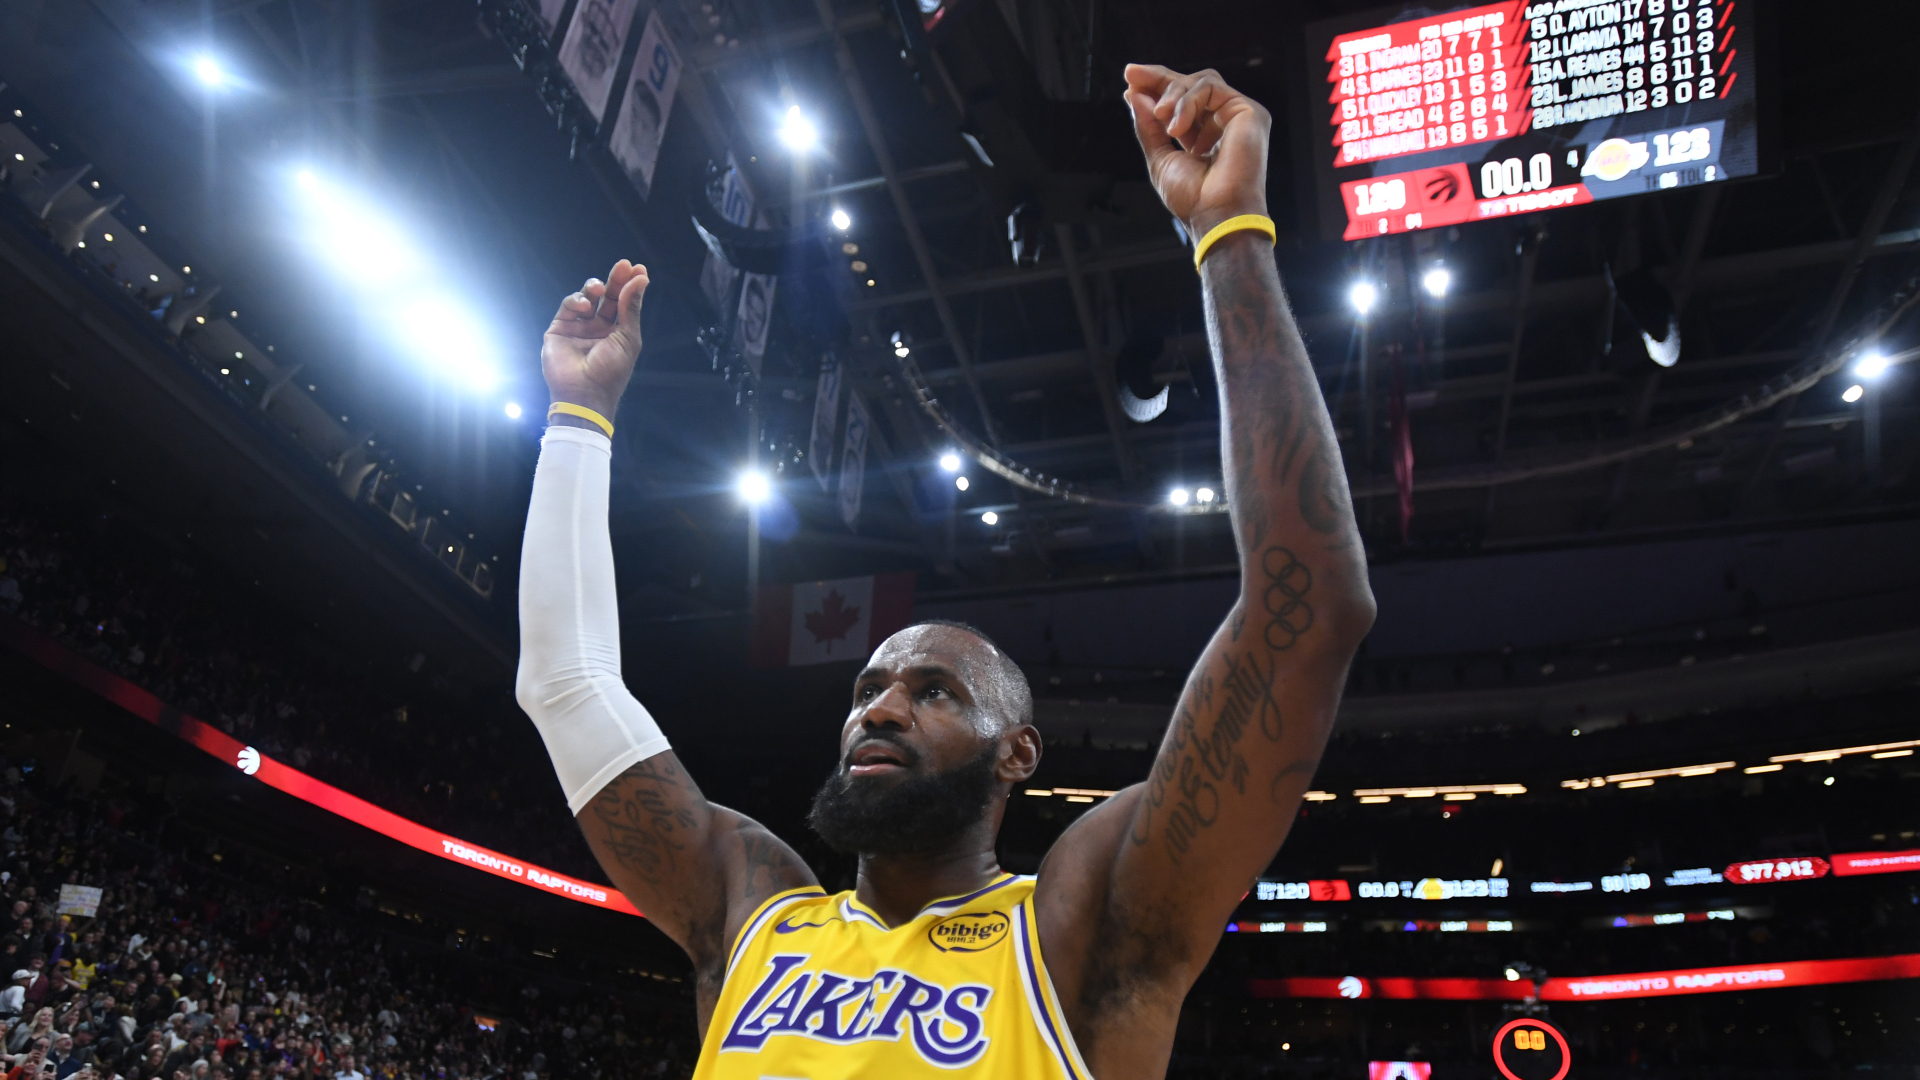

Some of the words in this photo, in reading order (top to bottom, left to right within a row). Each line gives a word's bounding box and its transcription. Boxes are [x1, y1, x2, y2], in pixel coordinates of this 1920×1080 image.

[1530, 17, 1547, 39] 5
[1550, 14, 1566, 36] D.
[1568, 2, 1620, 32] AYTON
[1622, 0, 1643, 22] 17
[1530, 40, 1551, 63] 12
[1562, 26, 1620, 56] LARAVIA
[1622, 21, 1644, 44] 14
[1649, 16, 1664, 38] 7
[1672, 12, 1690, 34] 0
[1696, 8, 1714, 30] 3
[1339, 57, 1354, 77] 3
[1369, 43, 1420, 71] INGRAM
[1421, 39, 1442, 61] 20
[1446, 35, 1460, 55] 7
[1468, 30, 1482, 51] 7
[1490, 27, 1502, 48] 1
[1530, 62, 1552, 85] 15
[1551, 60, 1566, 81] A.
[1566, 49, 1621, 78] REAVES
[1623, 44, 1645, 66] 44
[1650, 40, 1666, 62] 5
[1671, 35, 1694, 59] 11
[1697, 31, 1714, 53] 3
[1340, 77, 1356, 96] 4
[1356, 74, 1370, 95] S.
[1370, 64, 1422, 93] BARNES
[1422, 60, 1444, 83] 23
[1444, 56, 1465, 79] 11
[1491, 49, 1504, 70] 1
[1531, 84, 1554, 107] 23
[1553, 81, 1568, 104] L.
[1569, 70, 1624, 100] JAMES
[1626, 67, 1644, 90] 8
[1650, 63, 1668, 84] 6
[1672, 58, 1694, 82] 11
[1699, 54, 1714, 76] 1
[1341, 98, 1358, 120] 5
[1368, 86, 1422, 116] QUICKLEY
[1424, 82, 1445, 104] 13
[1450, 78, 1462, 100] 1
[1469, 74, 1485, 96] 5
[1490, 70, 1506, 92] 3
[1532, 106, 1555, 130] 28
[1624, 90, 1648, 113] 12
[1651, 86, 1668, 108] 3
[1674, 81, 1692, 104] 0
[1698, 77, 1715, 100] 2
[1341, 120, 1360, 142] 23
[1360, 118, 1372, 139] J.
[1373, 108, 1424, 136] SHEAD
[1428, 104, 1444, 124] 4
[1450, 100, 1465, 122] 2
[1470, 96, 1486, 118] 6
[1492, 92, 1508, 113] 4
[1426, 125, 1448, 148] 13
[1450, 122, 1466, 144] 8
[1472, 118, 1488, 140] 5
[1495, 114, 1508, 136] 1
[1653, 127, 1710, 167] 123
[1480, 152, 1552, 198] 00.0
[1704, 166, 1716, 182] 2
[1505, 188, 1578, 212] TISSOT
[442, 840, 524, 877] TORONTO
[526, 870, 606, 902] RAPTORS
[1358, 882, 1400, 898] 00.0
[1452, 880, 1489, 897] 123
[1740, 860, 1814, 881] $77,912
[1276, 882, 1310, 900] 120
[937, 922, 1005, 940] bibigo
[947, 936, 976, 944] 비비고
[1568, 978, 1669, 996] TORONTO
[1674, 969, 1785, 988] RAPTORS
[718, 953, 995, 1070] LAKERS
